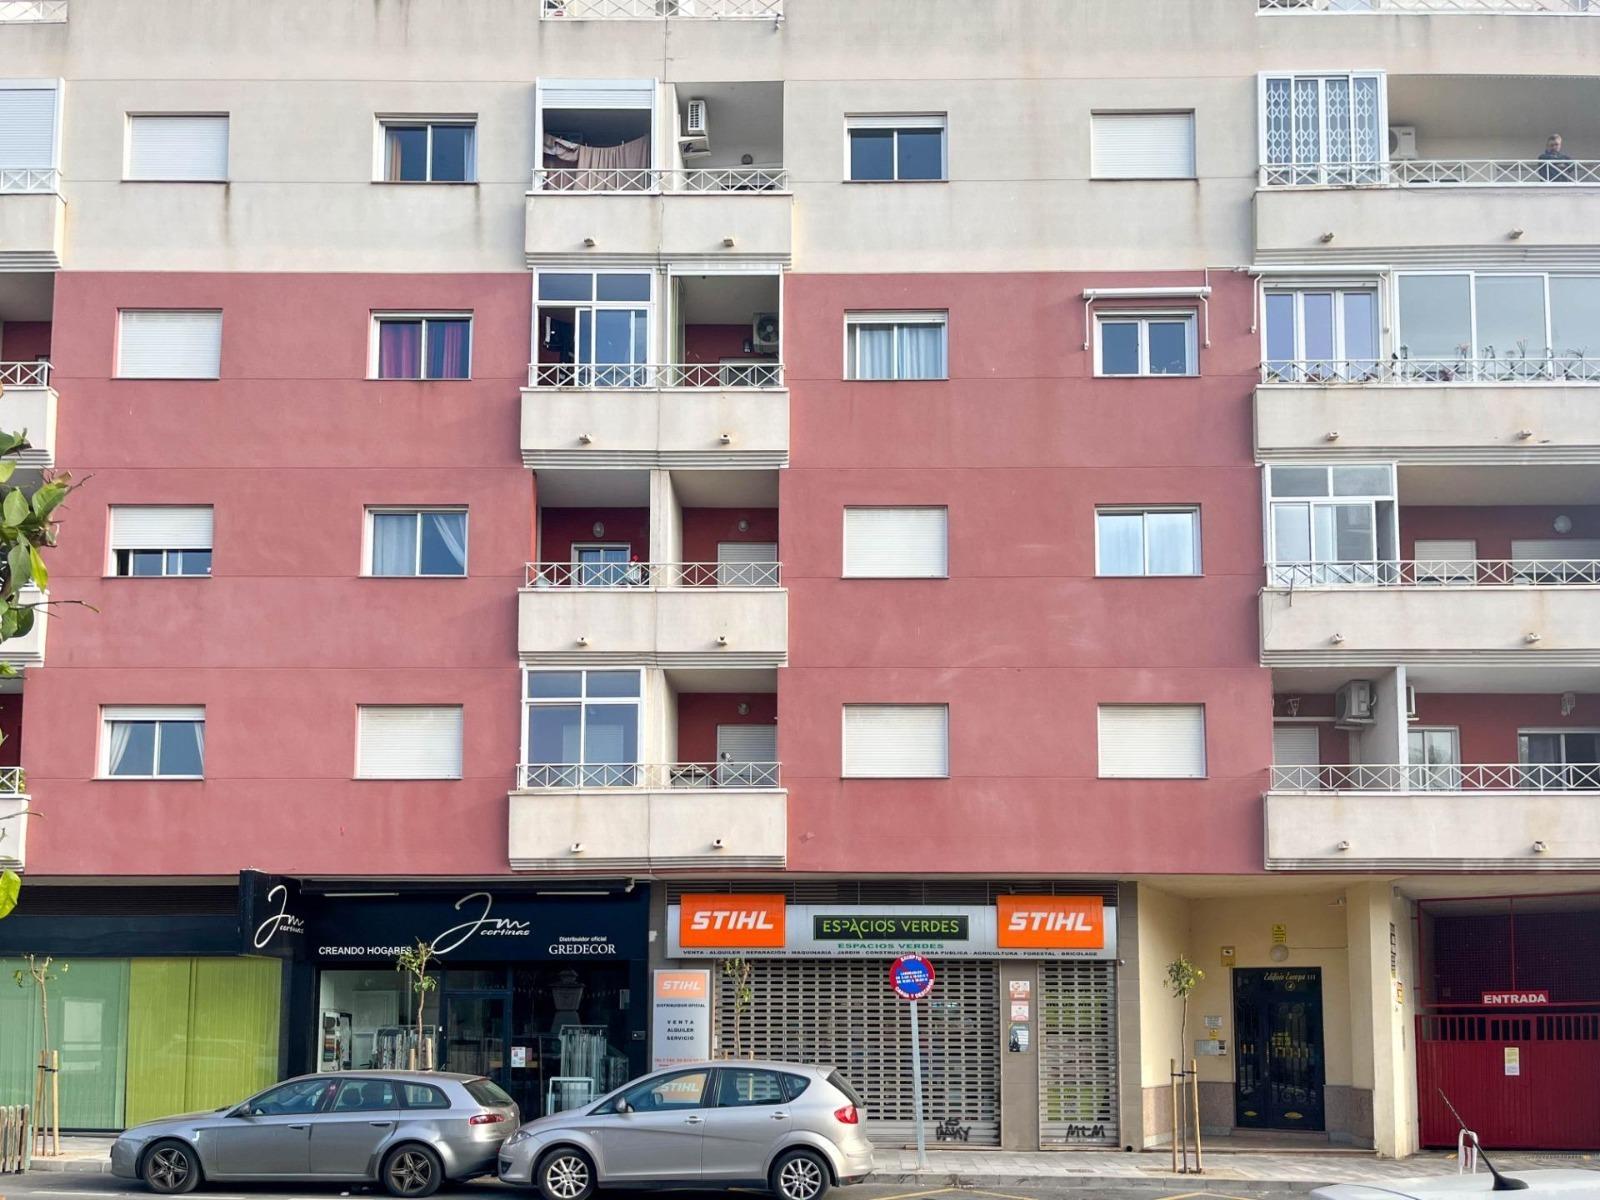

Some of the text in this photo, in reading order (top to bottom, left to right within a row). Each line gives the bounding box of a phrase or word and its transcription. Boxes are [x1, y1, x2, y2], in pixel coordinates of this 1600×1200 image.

[690, 911, 774, 930] STIHL
[1007, 912, 1093, 931] STIHL
[823, 918, 959, 939] ESPACIOS VERDES
[318, 946, 412, 955] CREANDO HOGARES
[549, 944, 616, 954] GREDECOR
[663, 981, 701, 990] STIHL
[1483, 994, 1547, 1004] ENTRADA
[661, 1083, 700, 1092] STIHL
